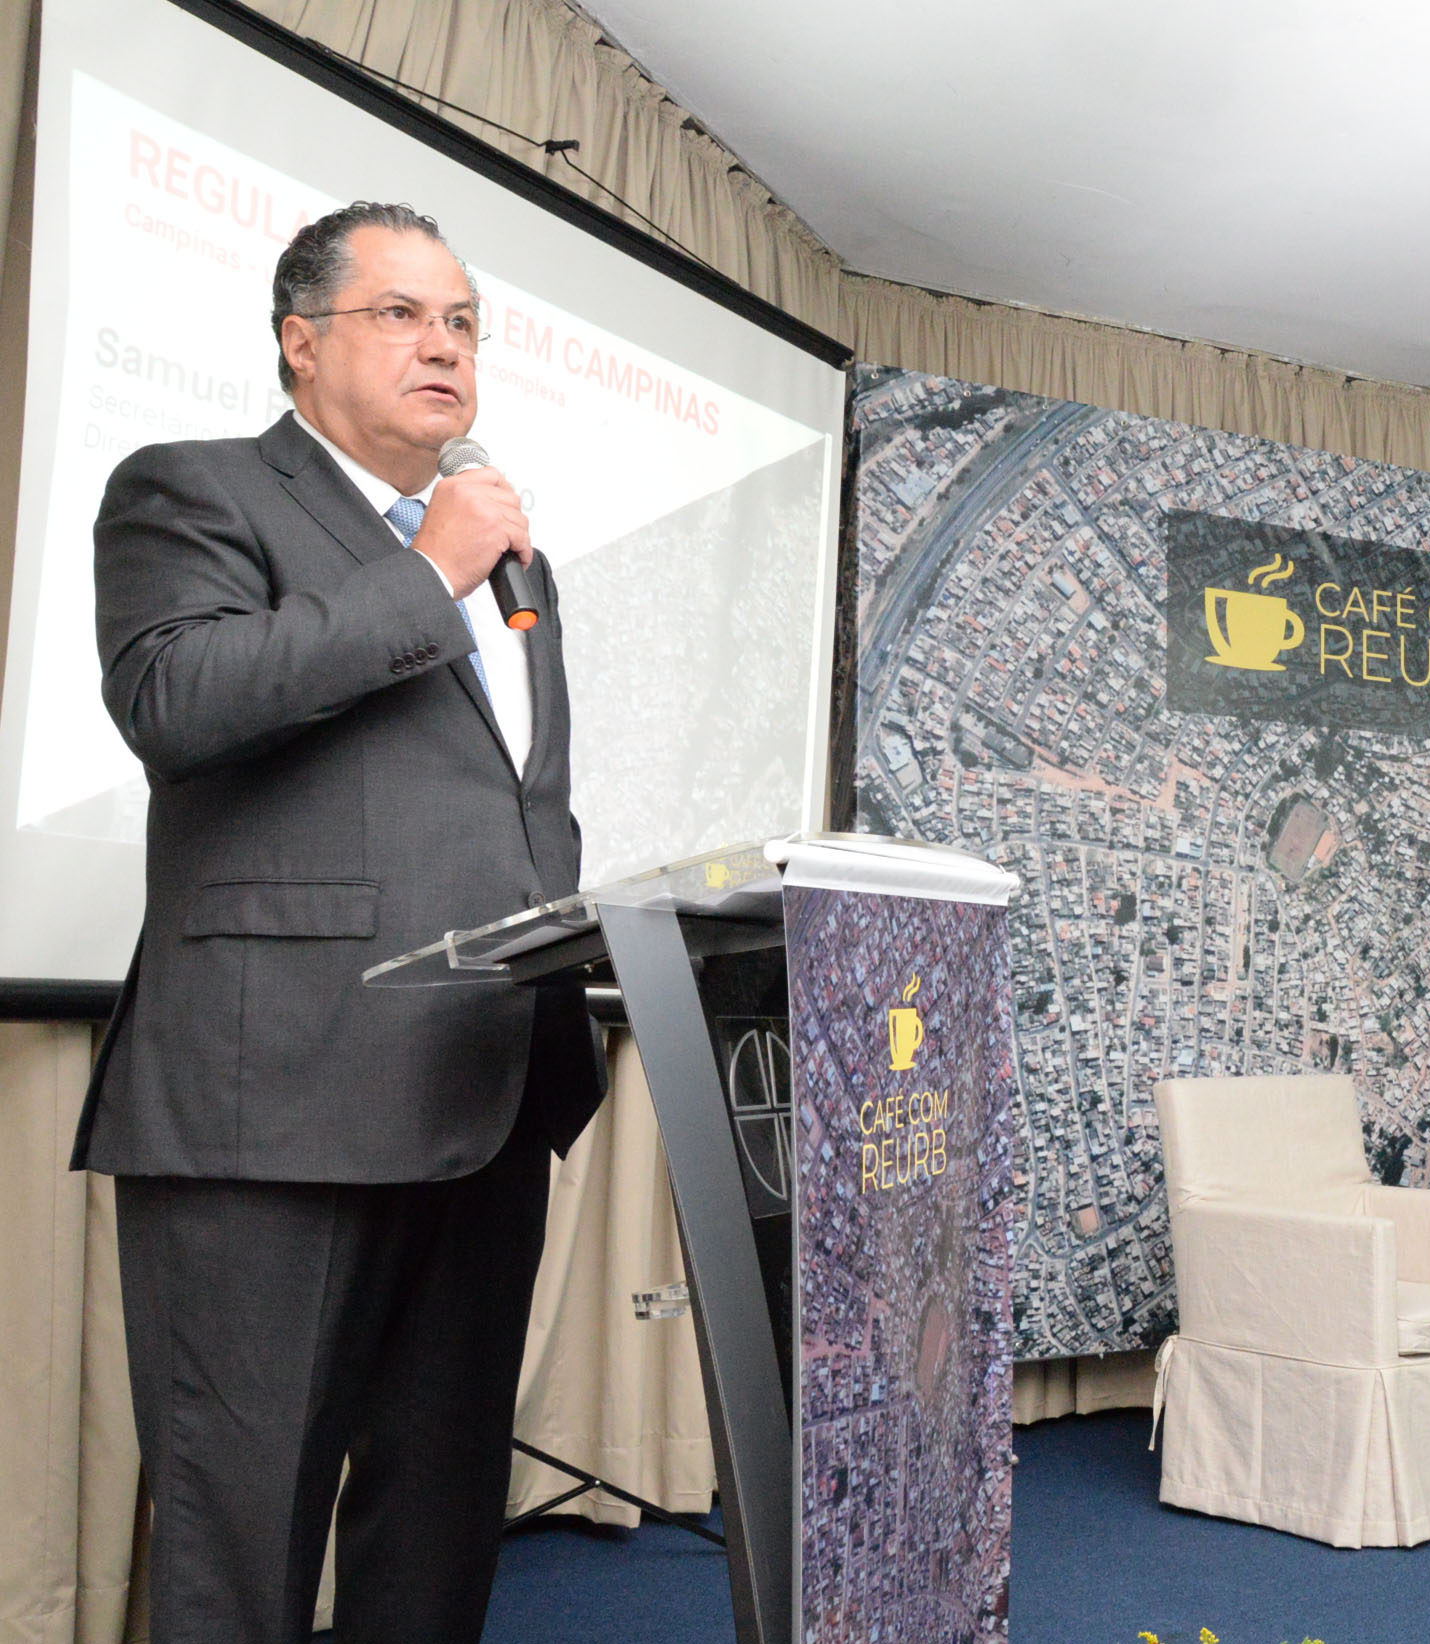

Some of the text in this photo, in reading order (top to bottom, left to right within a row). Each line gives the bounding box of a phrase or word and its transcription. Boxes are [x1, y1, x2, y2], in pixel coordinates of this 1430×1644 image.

[129, 129, 311, 246] REGULA
[124, 202, 242, 270] Campinas
[93, 326, 252, 417] Samuel
[488, 362, 567, 408] complexa
[504, 306, 554, 364] EM
[563, 336, 721, 437] CAMPINAS
[1315, 581, 1417, 629] CAFÉ
[860, 1089, 949, 1135] CAFÉ COM
[861, 1129, 948, 1195] REURB
